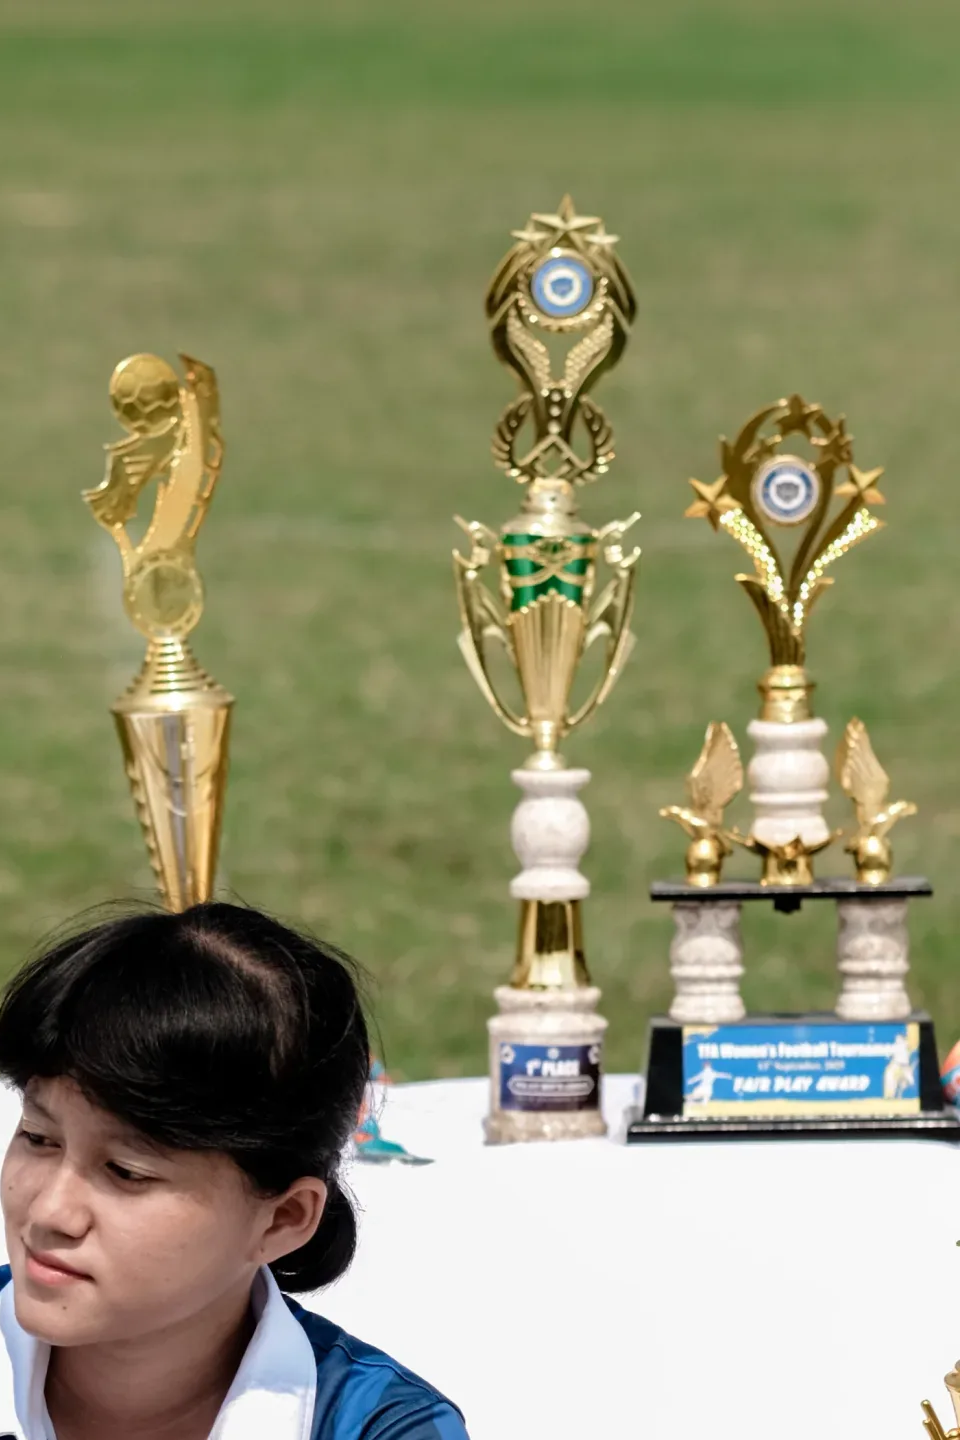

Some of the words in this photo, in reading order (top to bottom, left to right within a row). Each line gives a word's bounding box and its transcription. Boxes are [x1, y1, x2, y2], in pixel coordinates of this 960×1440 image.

[778, 1041, 828, 1059] Football
[733, 1076, 772, 1093] FAIR
[773, 1076, 814, 1092] PLAY
[815, 1075, 871, 1092] AWARD
